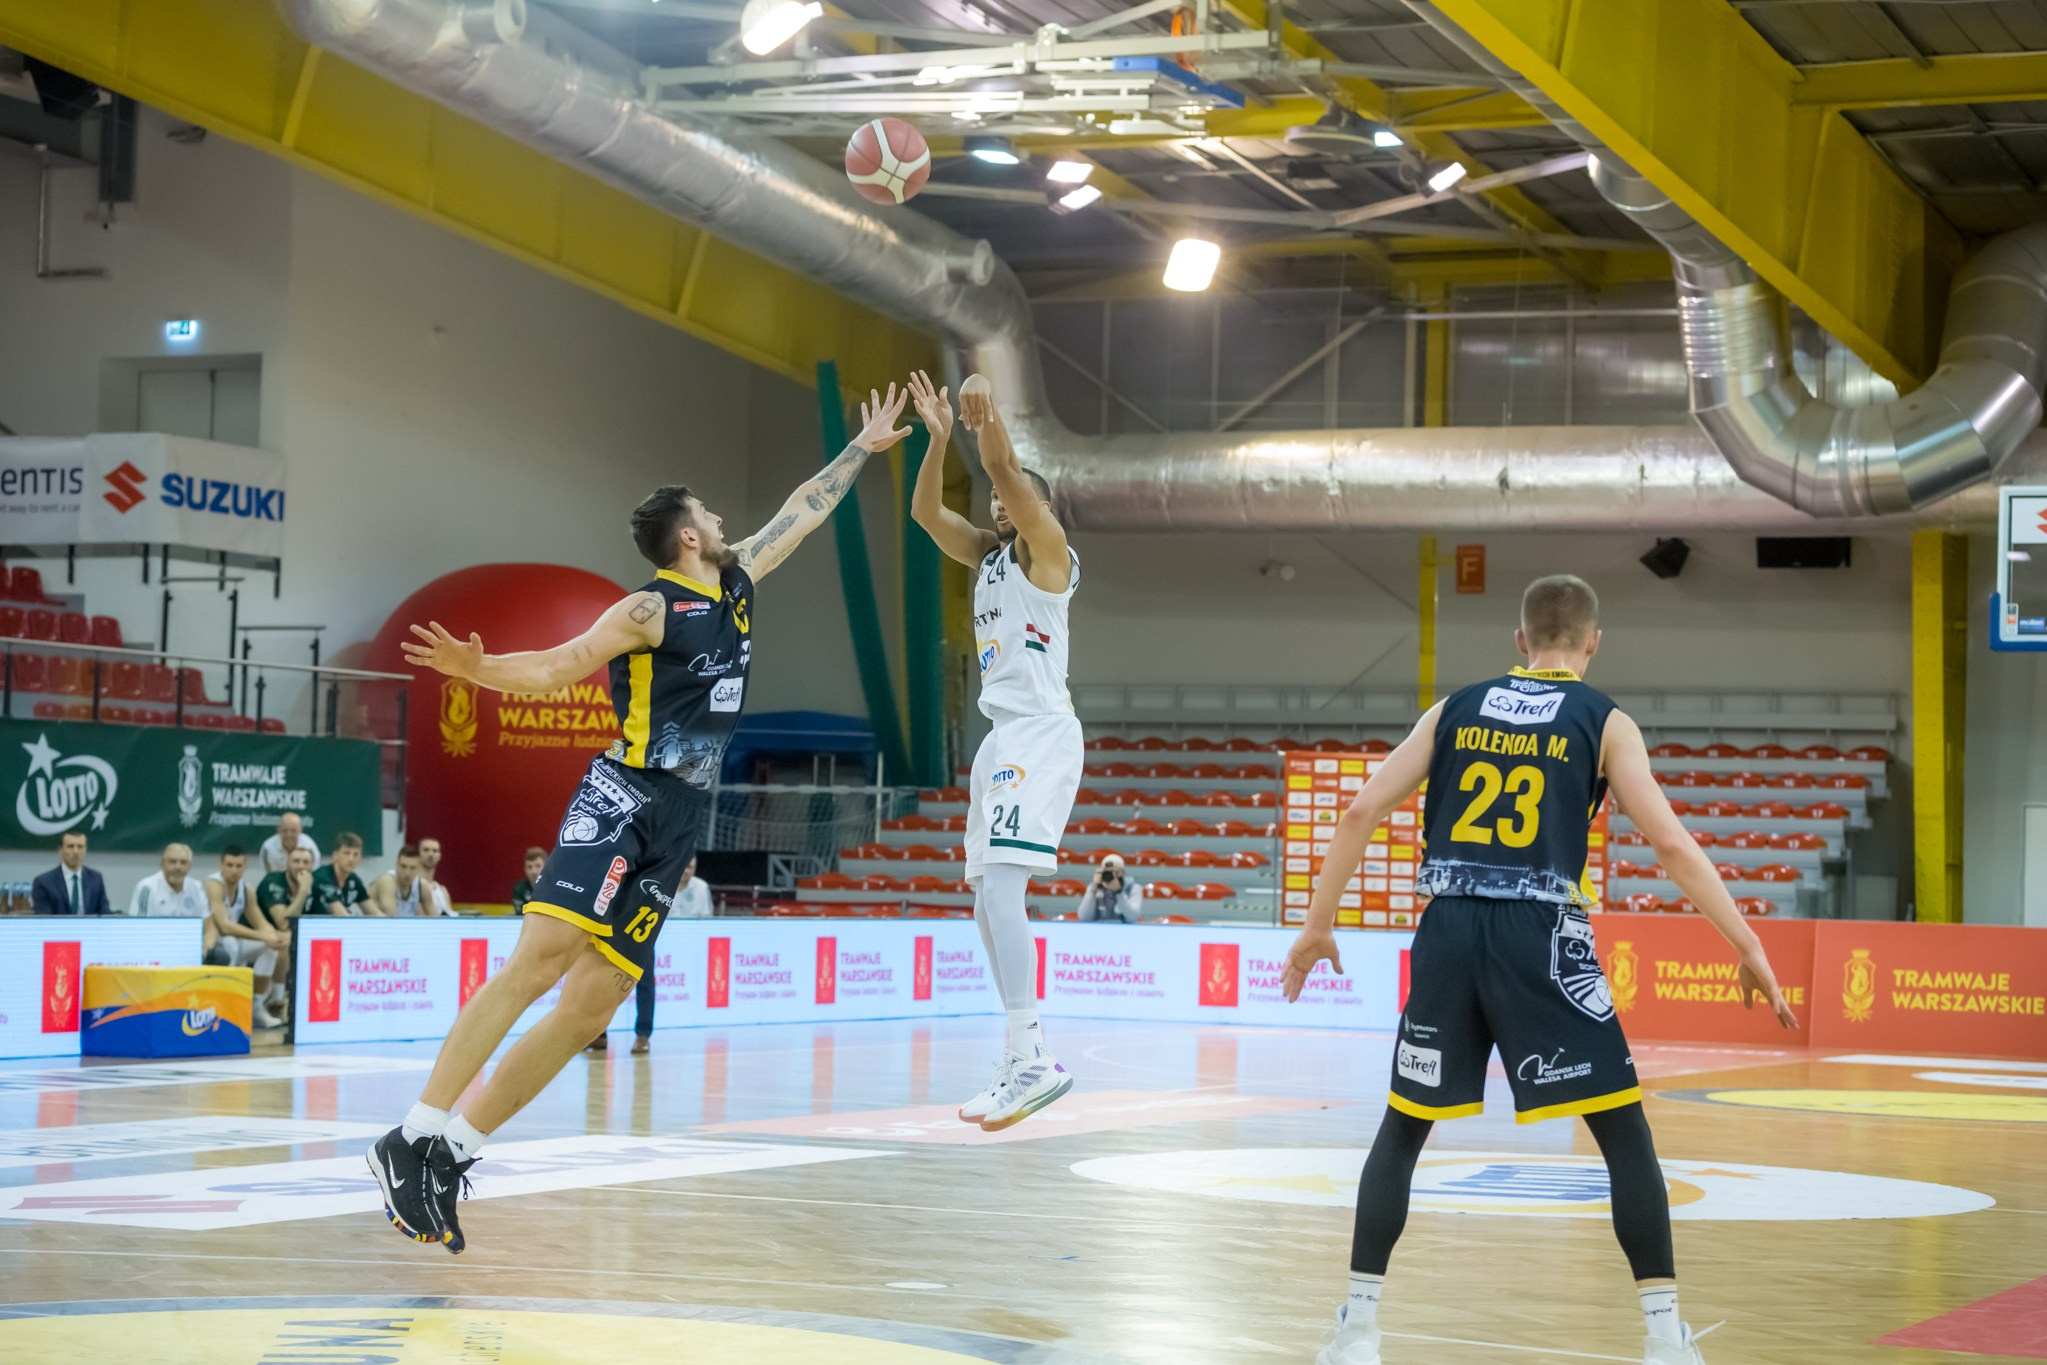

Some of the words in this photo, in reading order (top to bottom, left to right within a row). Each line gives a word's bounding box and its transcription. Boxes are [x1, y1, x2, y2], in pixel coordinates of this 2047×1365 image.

[160, 472, 285, 522] SUZUKI
[1462, 556, 1479, 581] F
[498, 706, 620, 731] WARSZAW
[1514, 699, 1557, 717] Trefl
[1455, 726, 1539, 757] KOLENDA
[1545, 734, 1570, 763] M.
[211, 762, 287, 786] TRAMWAJE
[36, 771, 99, 820] LOTTO
[211, 787, 307, 810] WARSZAWSKIE
[1450, 760, 1546, 849] 23
[578, 801, 601, 817] SOPOT
[990, 804, 1020, 837] 24
[556, 880, 585, 893] COLO
[624, 906, 659, 943] 13
[348, 957, 409, 974] TRAMWAJE
[1054, 952, 1132, 967] TRAMWAJE
[348, 978, 427, 995] WARSZAWSKIE
[1053, 970, 1156, 985] WARSZAWSKIE
[1892, 969, 2011, 992] TRAMWAJE
[1892, 991, 2046, 1016] WARSZAWSKIE
[1410, 1054, 1437, 1077] Trefl
[1533, 1074, 1561, 1085] WALESA
[1563, 1068, 1592, 1080] AIRPORT
[1544, 1066, 1574, 1078] GDANSK
[1574, 1061, 1592, 1072] LECH
